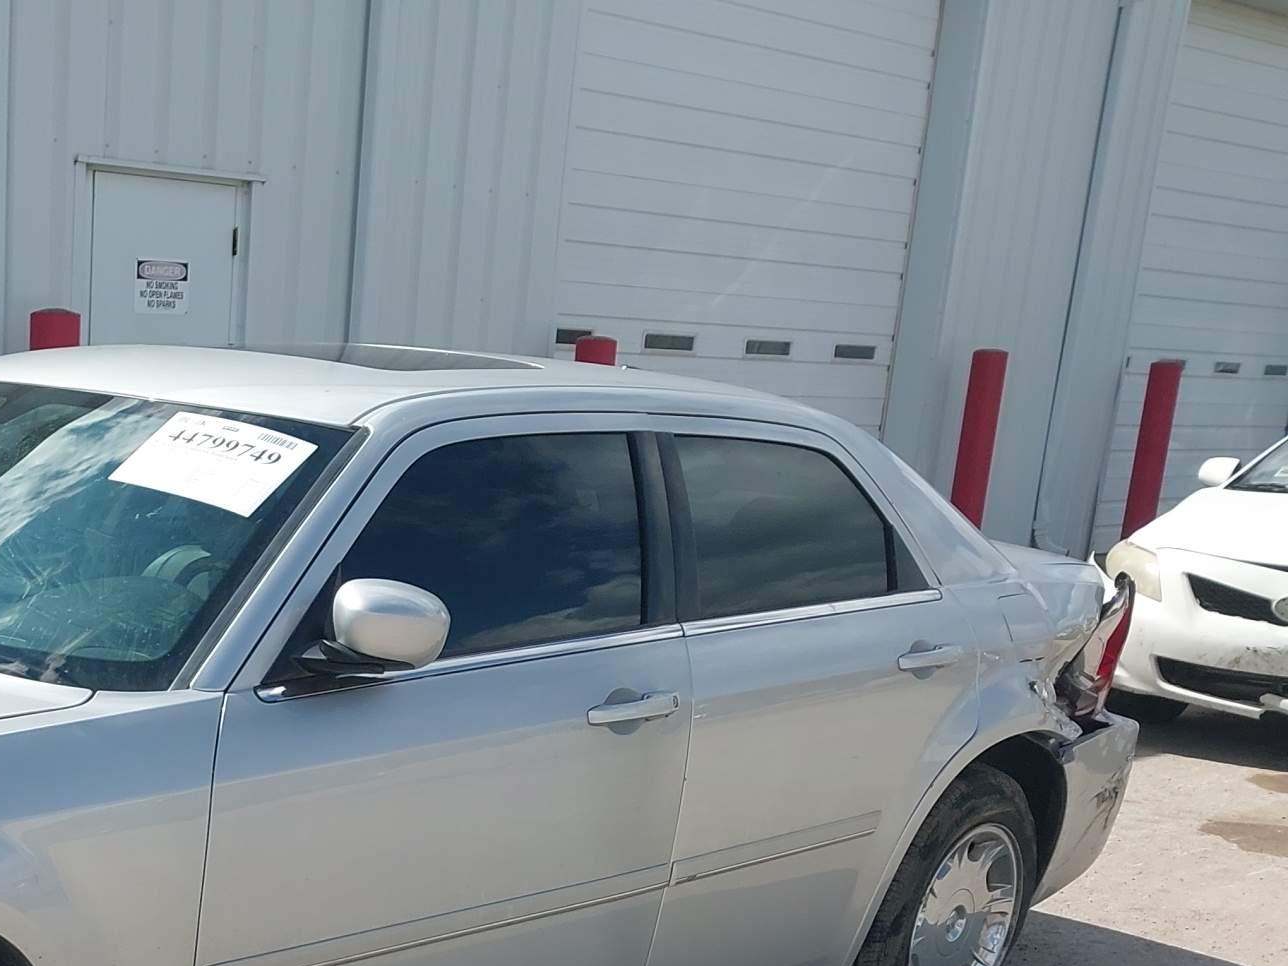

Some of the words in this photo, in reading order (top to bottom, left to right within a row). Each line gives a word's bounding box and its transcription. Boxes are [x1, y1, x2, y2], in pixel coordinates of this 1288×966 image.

[144, 264, 181, 277] DANGER
[146, 281, 154, 289] NO
[155, 281, 179, 290] SMOKING
[139, 290, 148, 298] NO
[149, 290, 162, 299] OPEN
[163, 291, 184, 300] FLAMES
[147, 300, 155, 308] NO
[156, 300, 176, 309] SPARKS
[169, 429, 282, 464] 44799749
